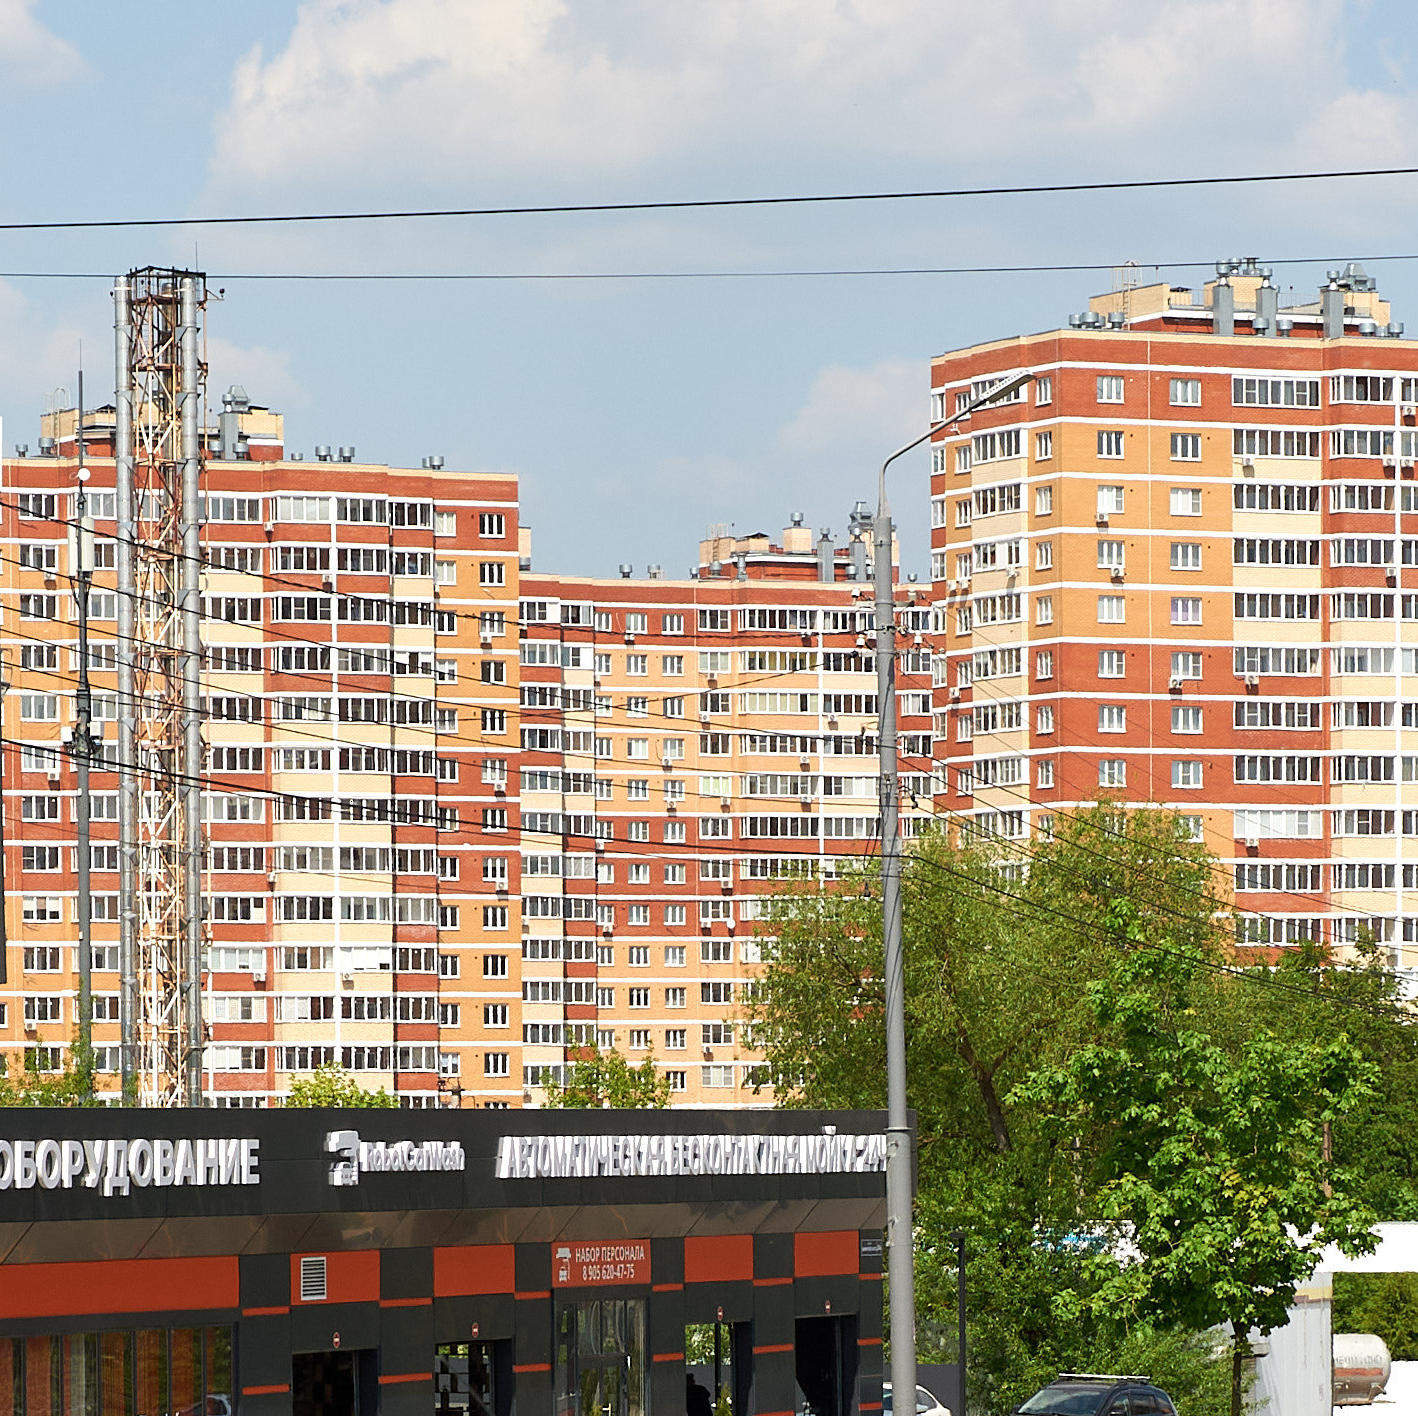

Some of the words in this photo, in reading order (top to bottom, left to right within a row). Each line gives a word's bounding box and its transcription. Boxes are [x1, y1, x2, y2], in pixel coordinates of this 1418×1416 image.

[495, 1135, 666, 1178] АВТОМАТИЧЕСКАЯ
[664, 1134, 800, 1176] БЕСКОНТАКТНАЯ
[800, 1125, 857, 1174] МОЙКА
[575, 1246, 600, 1262] НАБОР
[601, 1245, 645, 1262] ПЕРСОНАЛА
[582, 1265, 588, 1281] 8
[588, 1265, 601, 1280] 905
[601, 1263, 635, 1280] 620-47-75
